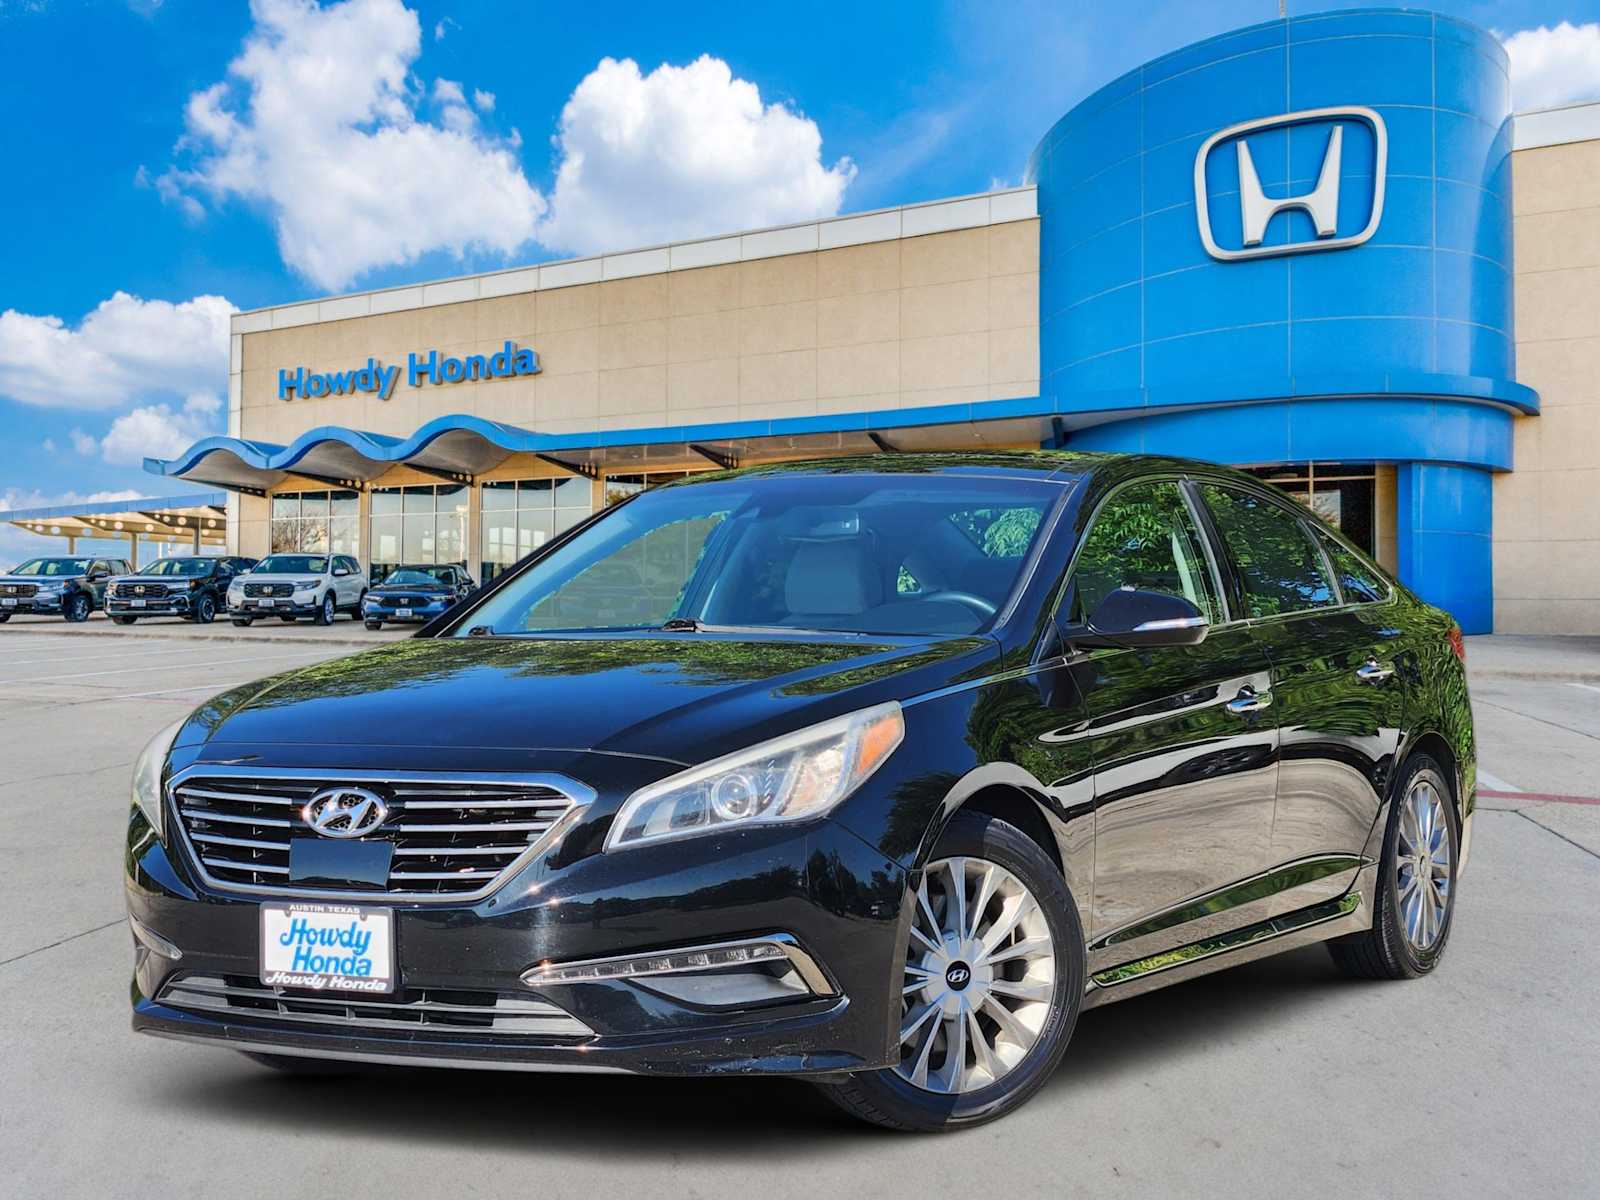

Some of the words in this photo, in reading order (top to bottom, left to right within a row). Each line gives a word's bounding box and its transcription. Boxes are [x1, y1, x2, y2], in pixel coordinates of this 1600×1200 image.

[278, 357, 401, 401] Howdy
[408, 340, 541, 388] Honda
[289, 904, 324, 912] AUSTIN
[280, 918, 371, 955] Howdy
[292, 945, 371, 976] Honda
[265, 971, 327, 989] Howdy
[328, 975, 387, 991] Honda
